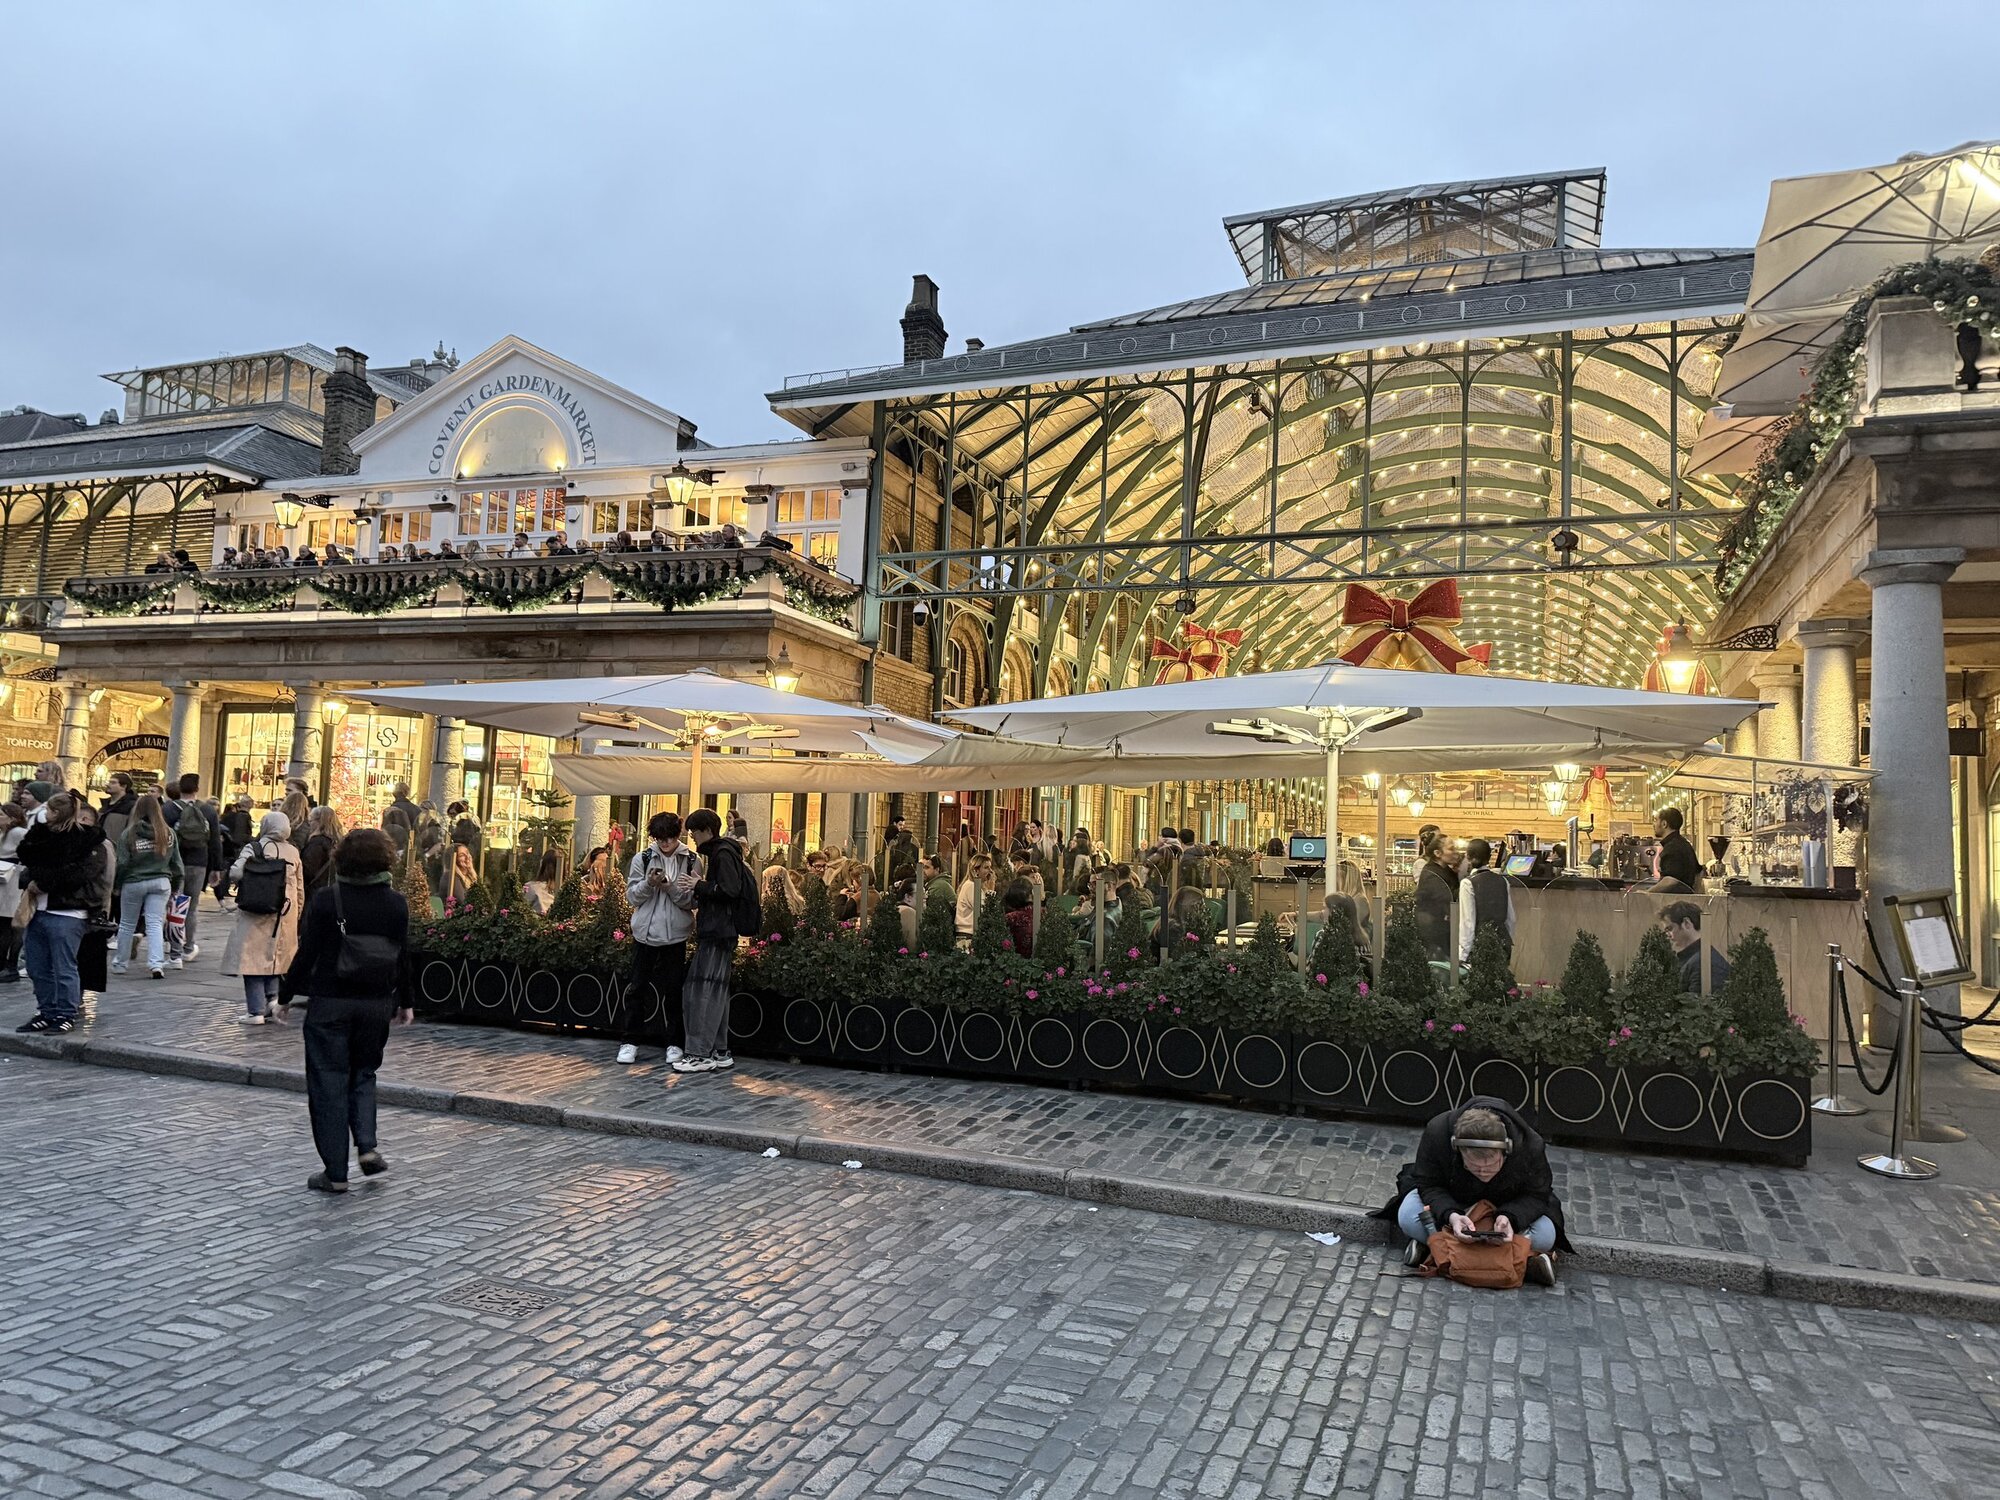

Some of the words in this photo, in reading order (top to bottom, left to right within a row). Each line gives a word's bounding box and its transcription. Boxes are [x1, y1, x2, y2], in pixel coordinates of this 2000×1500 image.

[428, 394, 476, 475] COVENT
[479, 374, 556, 400] GARDEN
[552, 385, 597, 466] MARKET
[484, 427, 545, 443] PUH
[5, 737, 27, 748] TOM
[27, 739, 54, 750] FORD
[116, 737, 140, 751] APPLE
[143, 736, 168, 749] MARK
[367, 771, 404, 787] WICKED
